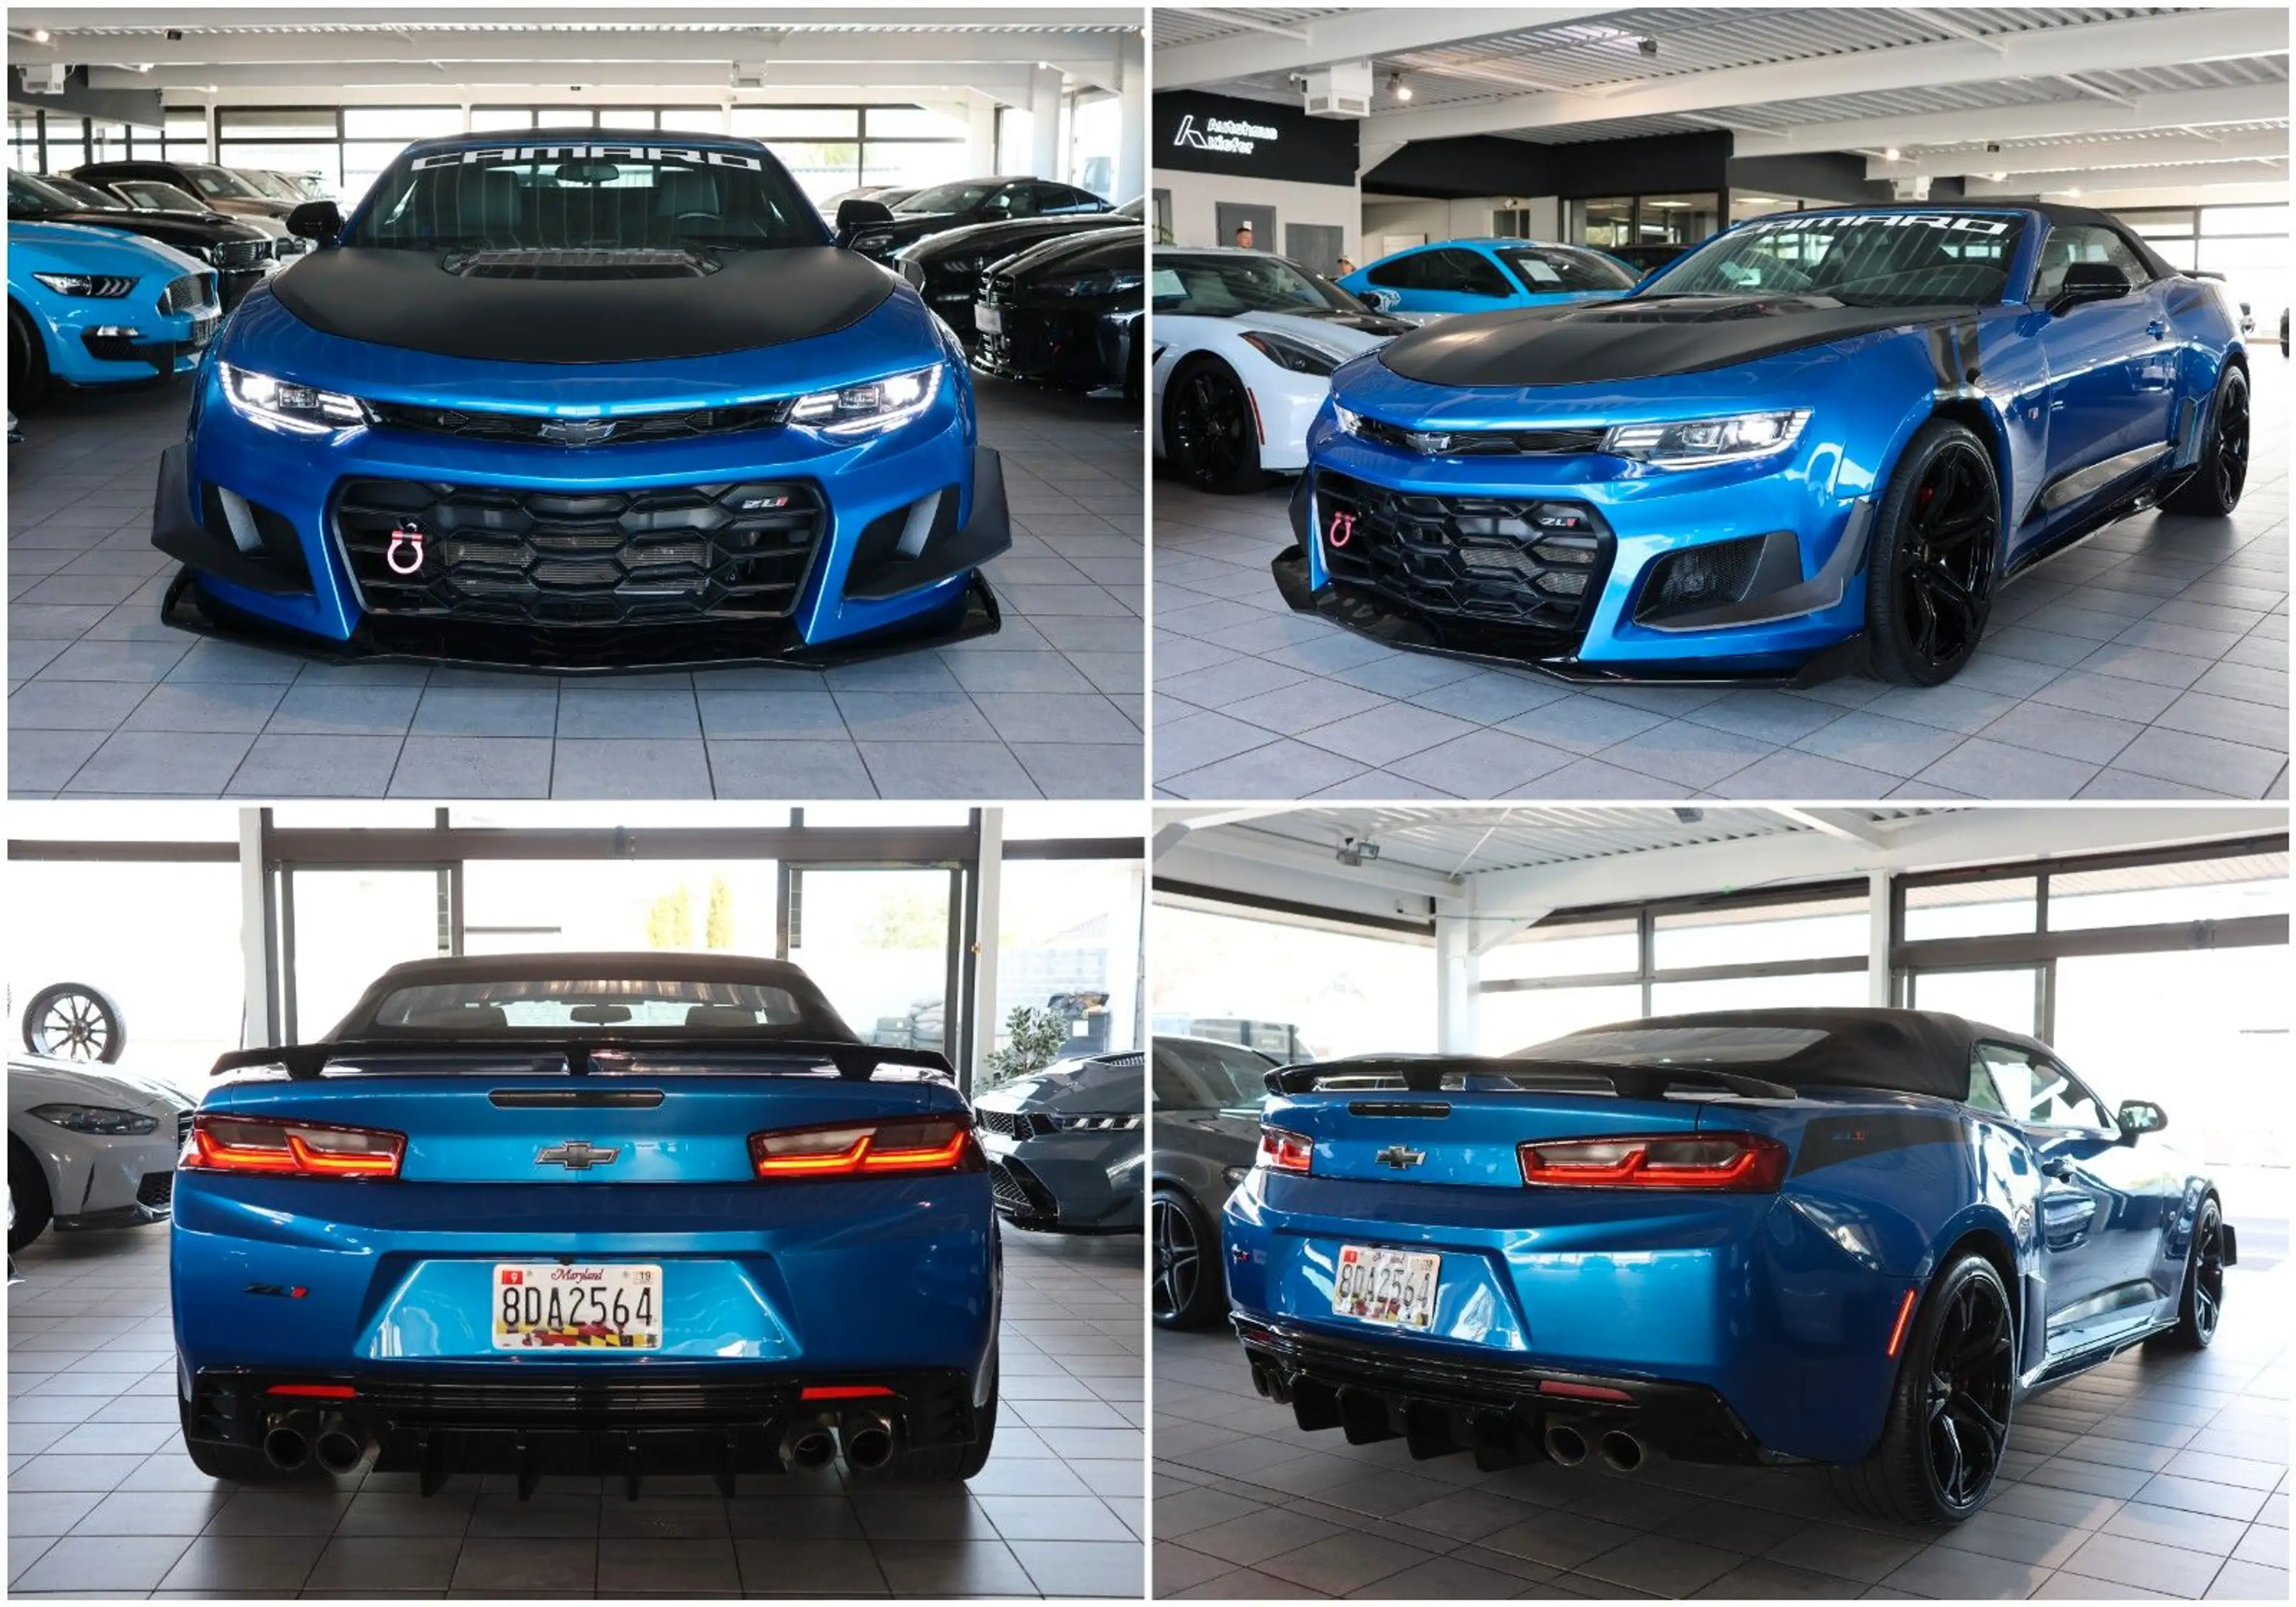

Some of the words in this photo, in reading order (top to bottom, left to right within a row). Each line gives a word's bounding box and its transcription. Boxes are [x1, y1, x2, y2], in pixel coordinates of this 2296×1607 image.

[411, 146, 762, 171] CAMARO
[510, 1272, 518, 1284] 9
[551, 1268, 604, 1284] Maryland
[1340, 1264, 1430, 1308] 8DA2564
[503, 1287, 652, 1327] 8DA2564
